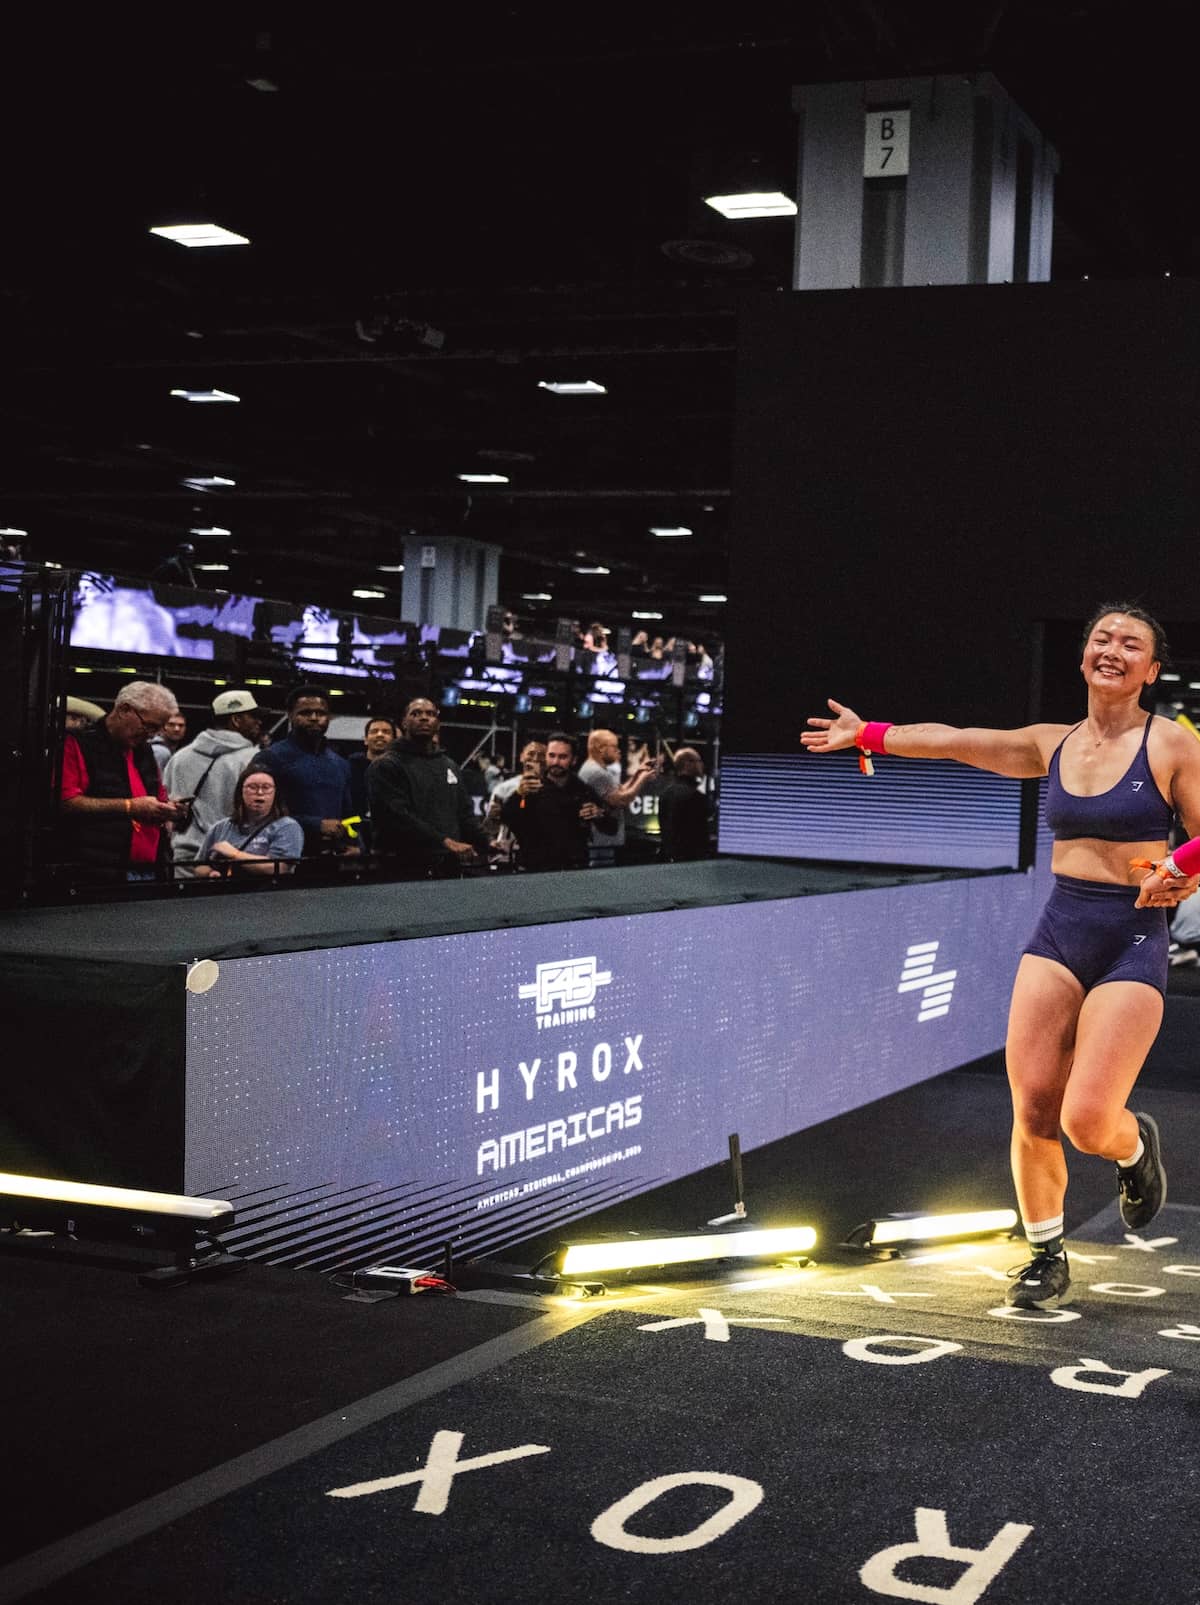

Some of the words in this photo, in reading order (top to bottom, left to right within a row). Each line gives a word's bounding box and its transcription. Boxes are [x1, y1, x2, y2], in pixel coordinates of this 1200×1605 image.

[881, 118, 894, 140] B
[881, 147, 894, 169] 7
[536, 956, 597, 1014] F45
[536, 1006, 596, 1030] TRAINING
[477, 1034, 643, 1113] HYROX
[476, 1095, 643, 1176] AMERICAS
